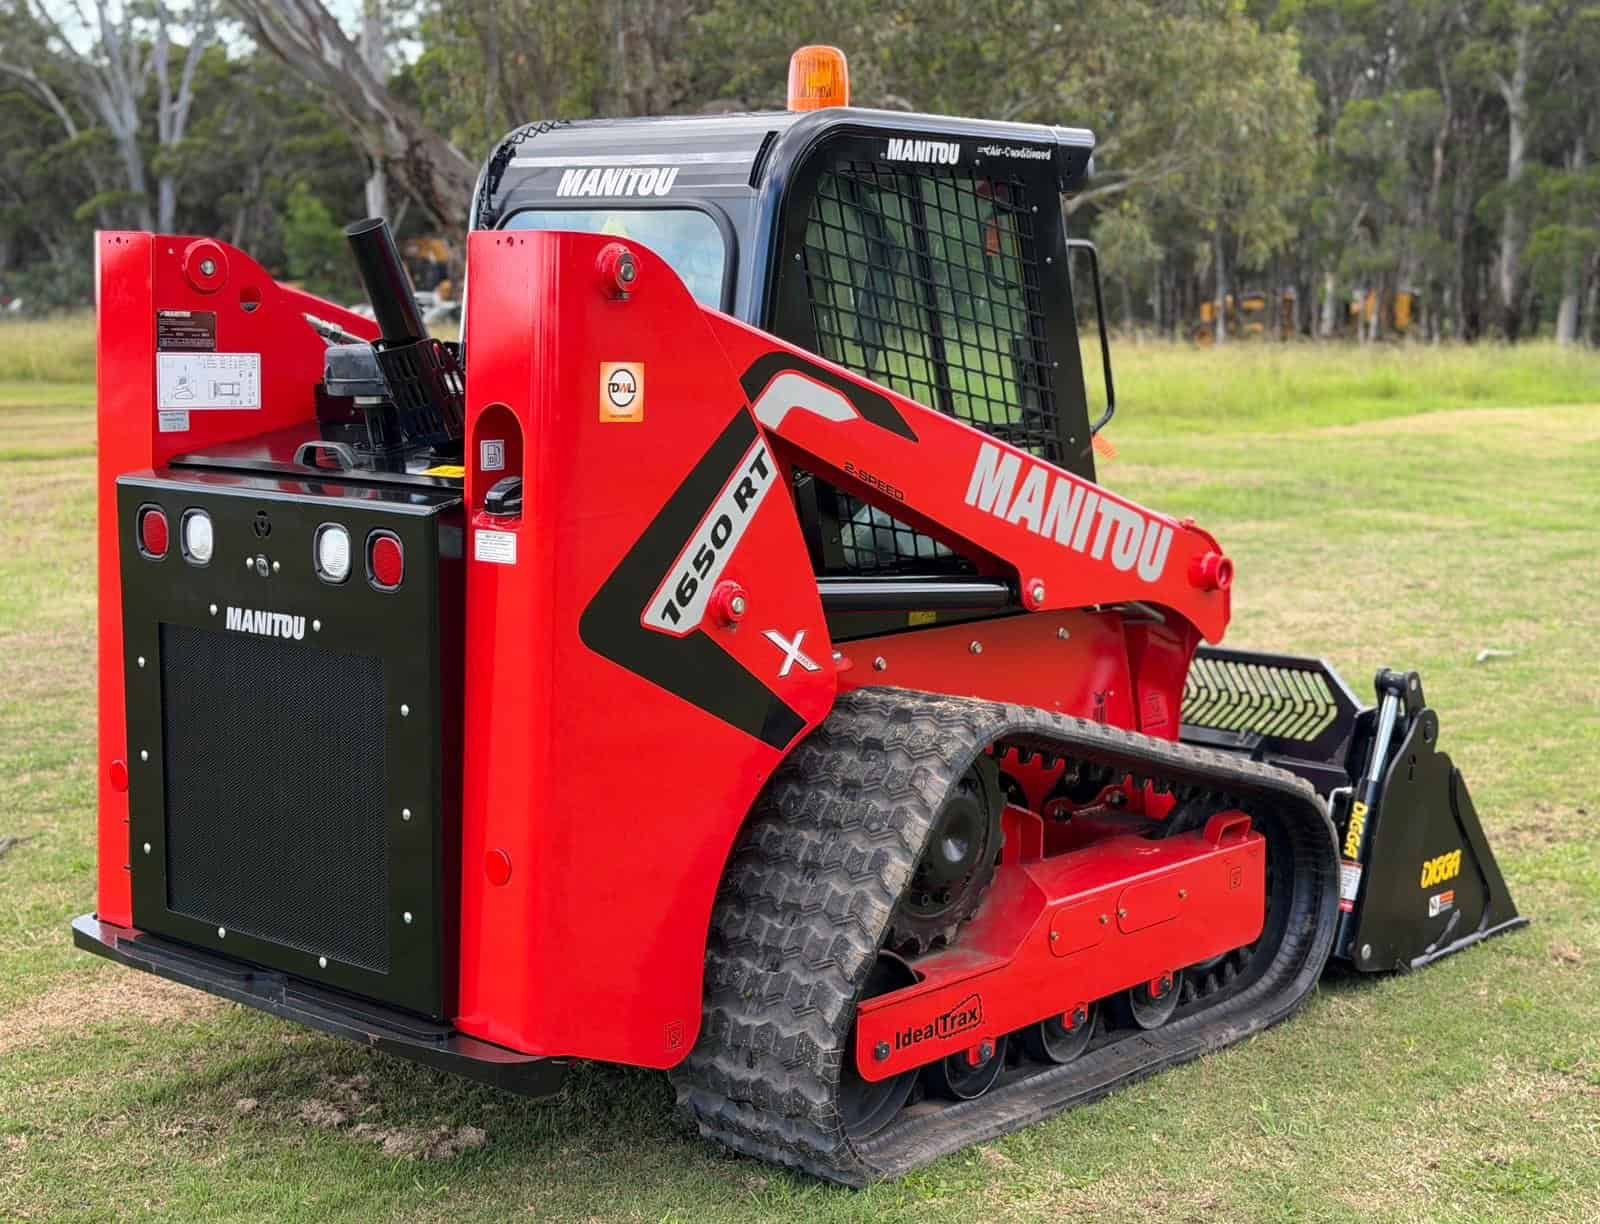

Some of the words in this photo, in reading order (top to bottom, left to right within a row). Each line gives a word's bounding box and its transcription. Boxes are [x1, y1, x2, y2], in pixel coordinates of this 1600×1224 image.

[886, 138, 960, 165] MANITOU
[556, 167, 680, 196] MANITOU
[844, 461, 905, 501] 2-SPEED
[964, 441, 1174, 583] MANITOU
[660, 514, 733, 625] 1650
[733, 448, 769, 514] RT
[226, 606, 306, 640] MANITOU
[1344, 800, 1369, 860] DIGGA
[1421, 849, 1462, 889] DIGGA
